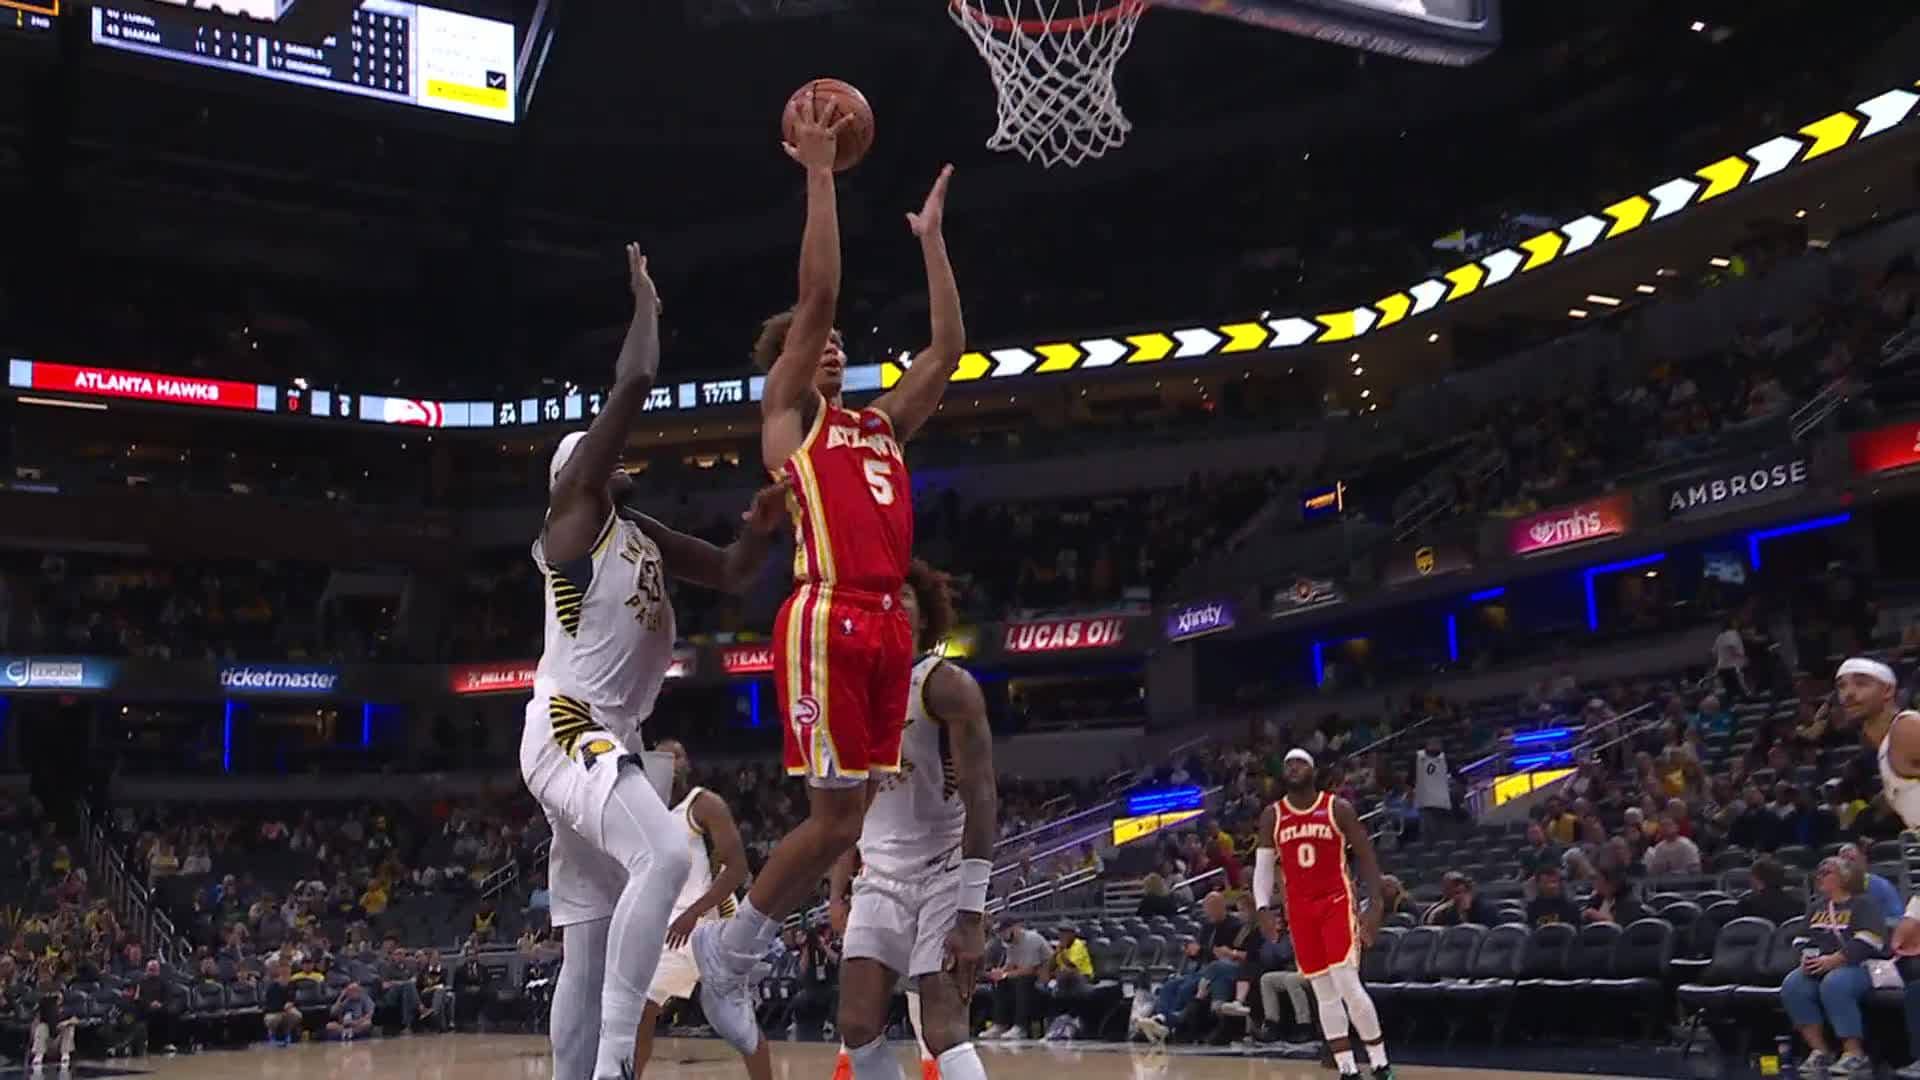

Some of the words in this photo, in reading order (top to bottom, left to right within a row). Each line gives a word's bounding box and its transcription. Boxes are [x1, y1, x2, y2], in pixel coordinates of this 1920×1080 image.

[74, 371, 153, 394] ATLANTA
[156, 379, 219, 401] HAWKS
[500, 408, 516, 425] 24
[544, 404, 560, 420] 10
[863, 457, 895, 505] 5
[1668, 459, 1807, 511] AMBROSE
[1556, 508, 1601, 541] mhs
[1178, 603, 1223, 632] xfinity
[1004, 622, 1081, 649] LUCAS
[1087, 618, 1123, 644] OIL
[220, 666, 338, 689] ticketmaster
[1279, 823, 1333, 845] ATLANTA
[1297, 842, 1316, 869] 0
